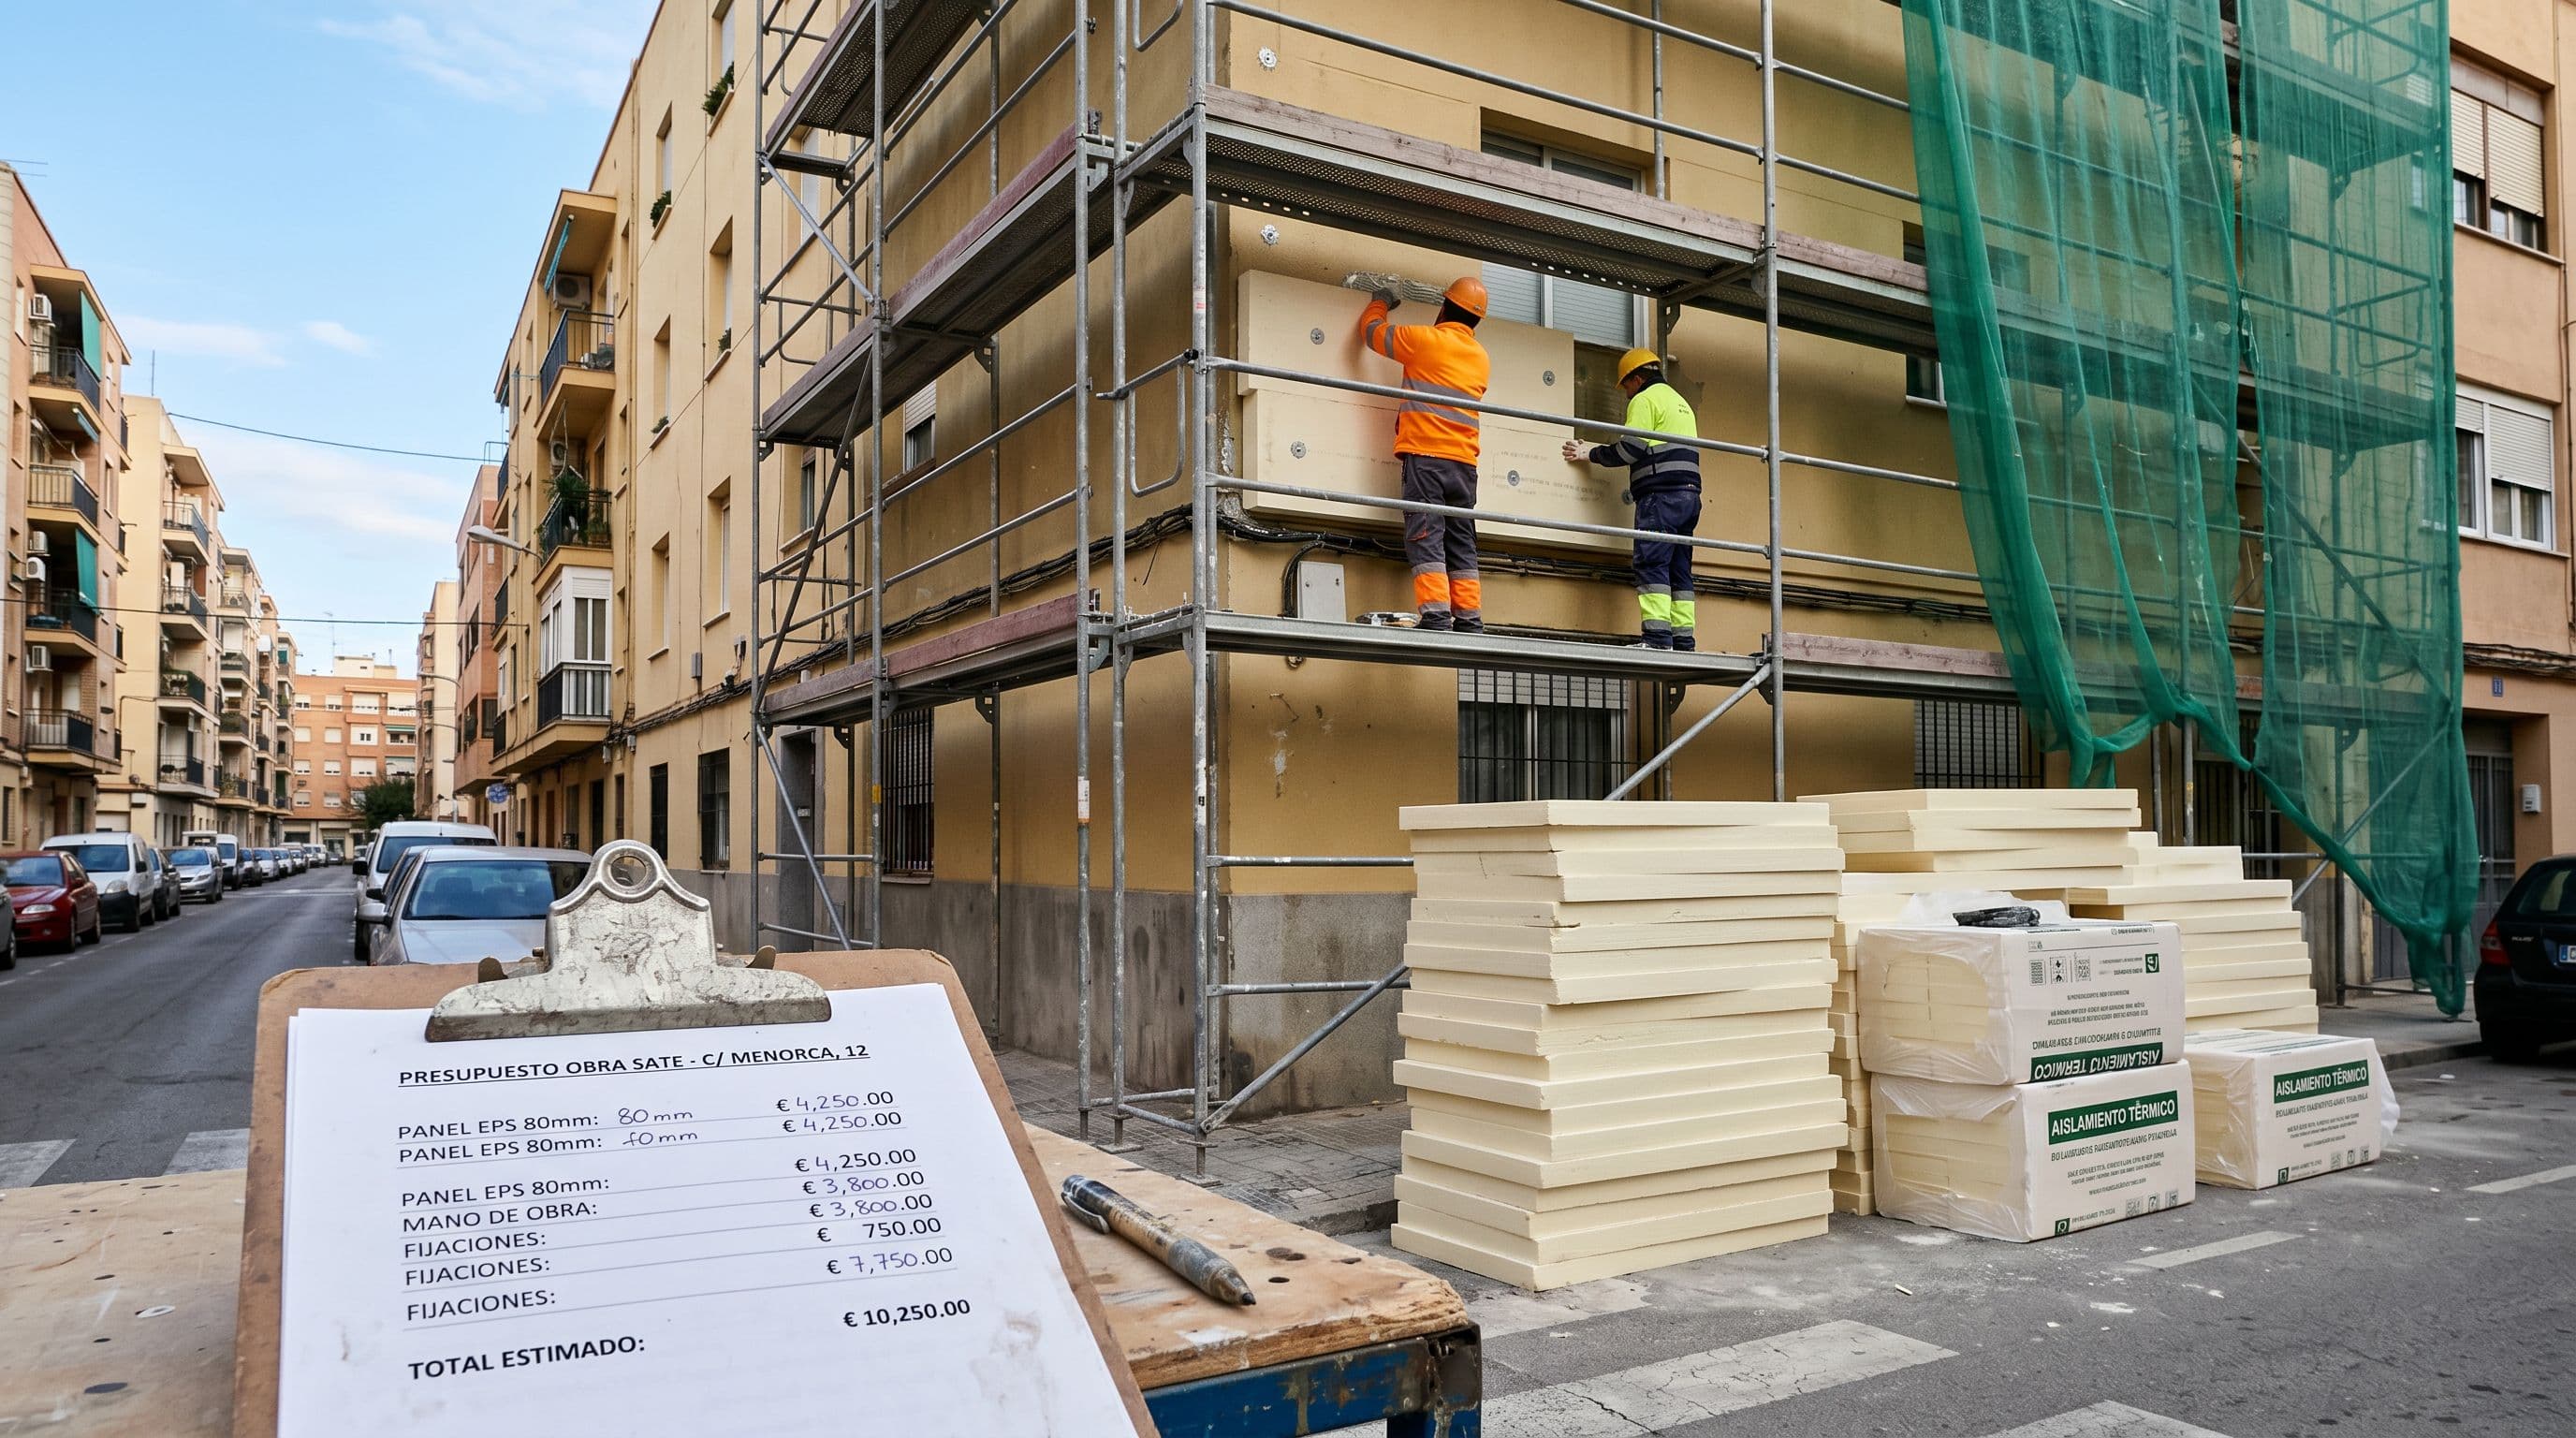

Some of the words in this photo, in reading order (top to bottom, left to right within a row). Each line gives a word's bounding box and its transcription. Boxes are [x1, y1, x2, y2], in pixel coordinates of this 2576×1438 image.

[399, 1063, 559, 1084] PRESUPUESTO
[565, 1059, 628, 1075] OBRA
[632, 1055, 684, 1071] SATE
[701, 1050, 724, 1068] C/
[730, 1045, 842, 1064] MENORCA,
[844, 1044, 870, 1058] 12
[2276, 1074, 2332, 1097] AISLAMIENTO
[775, 1098, 791, 1112] €
[796, 1091, 894, 1114] 4,250.00
[398, 1122, 473, 1139] PANEL
[478, 1119, 518, 1134] EPS
[523, 1115, 599, 1131] 80mm:
[782, 1119, 797, 1133] €
[803, 1111, 902, 1134] 4,250.00
[2051, 1108, 2127, 1137] AISLAMIENTO
[399, 1144, 474, 1164] PANEL
[480, 1140, 520, 1157] EPS
[526, 1137, 602, 1153] 80mm:
[794, 1158, 811, 1173] €
[815, 1148, 916, 1172] 4,250.00
[402, 1187, 478, 1208] PANEL
[484, 1182, 526, 1200] EPS
[532, 1179, 609, 1196] 80mm:
[801, 1181, 817, 1195] €
[822, 1170, 925, 1196] 3,800.00
[402, 1211, 481, 1233] MANO
[489, 1208, 520, 1225] DE
[526, 1201, 597, 1221] OBRA:
[809, 1203, 825, 1218] €
[829, 1194, 933, 1219] 3,800.00
[816, 1226, 832, 1243] €
[861, 1217, 942, 1239] 750.00
[404, 1231, 547, 1259] FIJACIONES:
[405, 1257, 550, 1286] FIJACIONES:
[826, 1259, 842, 1275] €
[848, 1247, 953, 1275] 7,750.00
[406, 1289, 556, 1322] FIJACIONES:
[842, 1312, 858, 1328] €
[862, 1299, 971, 1327] 10,250.00
[407, 1354, 495, 1381] TOTAL
[501, 1335, 645, 1369] ESTIMADO:
